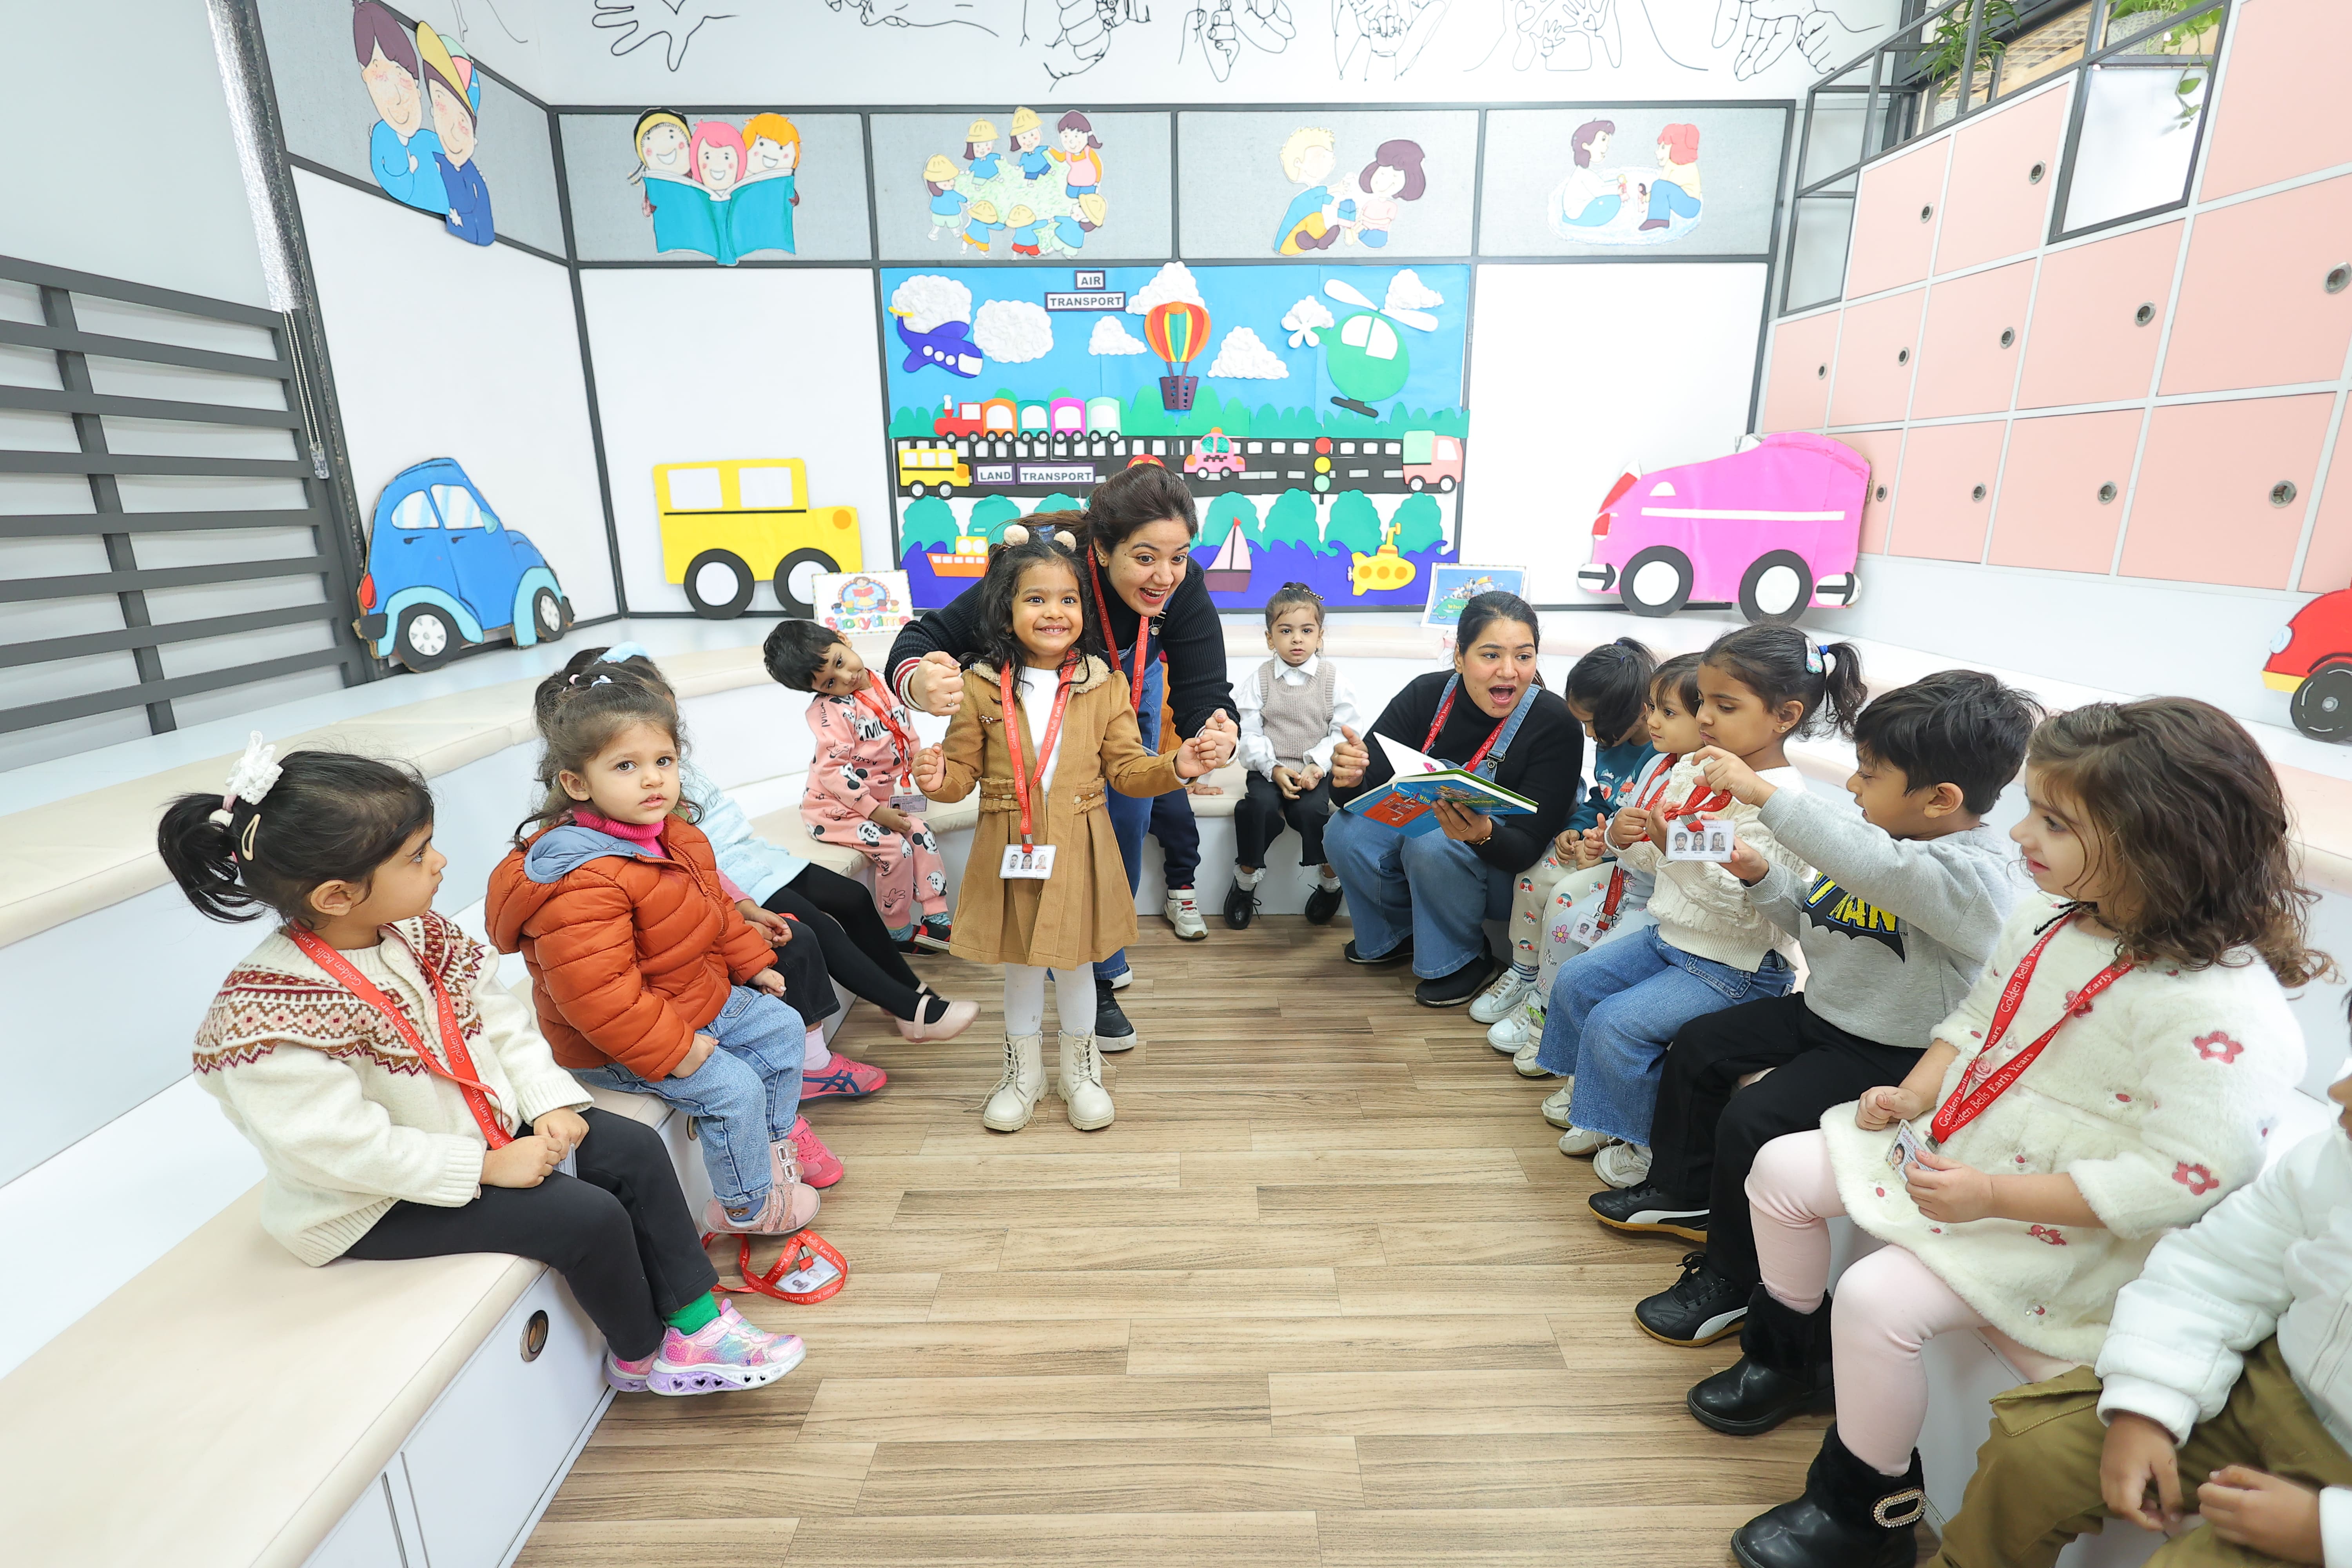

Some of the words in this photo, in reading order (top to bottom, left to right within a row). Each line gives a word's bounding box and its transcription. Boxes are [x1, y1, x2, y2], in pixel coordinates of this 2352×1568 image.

[1081, 276, 1101, 285] AIR
[1049, 297, 1122, 307] TRANSPORT
[980, 472, 1011, 480] LAND
[1022, 472, 1091, 481] TRANSPORT
[825, 615, 911, 630] Storytime
[1422, 737, 1432, 753] Golden
[1435, 715, 1445, 727] Early
[1441, 702, 1451, 714] Years
[1045, 731, 1054, 750] Golden
[1472, 750, 1485, 765] Golden
[1483, 740, 1492, 751] Bells
[1490, 728, 1501, 740] Early
[1036, 765, 1045, 779] Years
[1654, 760, 1669, 775] Golden
[1419, 794, 1431, 804] Who
[1607, 894, 1616, 911] Golden
[315, 947, 335, 965] Bells
[334, 961, 361, 986] Golden
[2000, 981, 2023, 1013] Golden
[2014, 960, 2032, 980] Bells
[2029, 936, 2048, 958] Early
[2085, 972, 2113, 995] Early
[379, 1001, 396, 1021] Years
[440, 994, 449, 1015] Early
[396, 1019, 412, 1038] Early
[442, 1016, 454, 1035] Bells
[412, 1038, 425, 1054] Bells
[1985, 1025, 2002, 1049] Years
[450, 1035, 465, 1063] Golden
[426, 1053, 448, 1076] Golden
[1970, 1091, 1991, 1109] Bells
[1986, 1071, 2014, 1094] Early
[2007, 1053, 2034, 1073] Years
[1938, 1096, 1960, 1127] Golden
[1957, 1075, 1969, 1095] Bells
[478, 1103, 491, 1124] Early
[486, 1123, 501, 1142] Bells
[1902, 1131, 1913, 1147] Golden
[786, 1243, 797, 1257] Bells
[806, 1235, 819, 1247] Bells
[818, 1245, 833, 1259] Early
[833, 1255, 844, 1270] Years
[776, 1258, 788, 1272] Early
[807, 1293, 822, 1303] Bells
[823, 1281, 843, 1296] Golden
